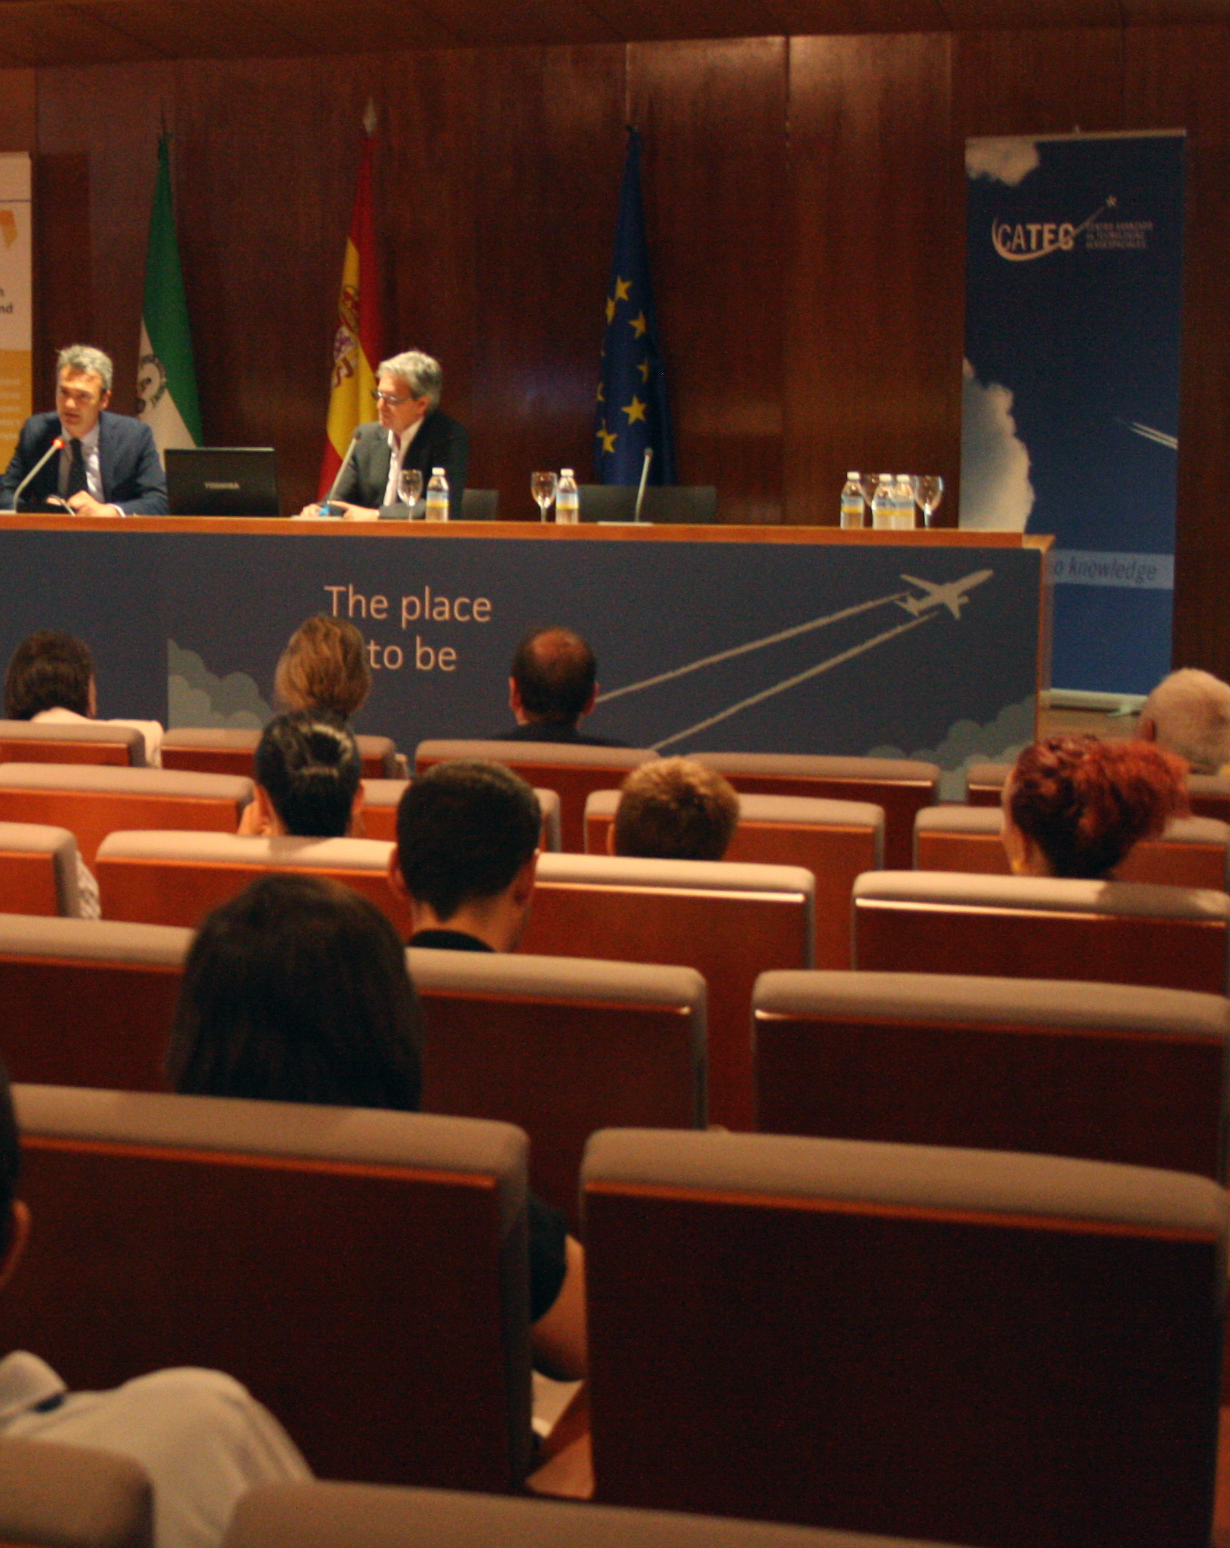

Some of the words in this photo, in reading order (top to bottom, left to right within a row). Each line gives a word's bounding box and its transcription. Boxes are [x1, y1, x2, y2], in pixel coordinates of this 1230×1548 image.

[1068, 557, 1157, 584] knowledge
[323, 583, 389, 619] The
[401, 585, 492, 629] place
[367, 639, 404, 670] to
[416, 635, 457, 671] be
